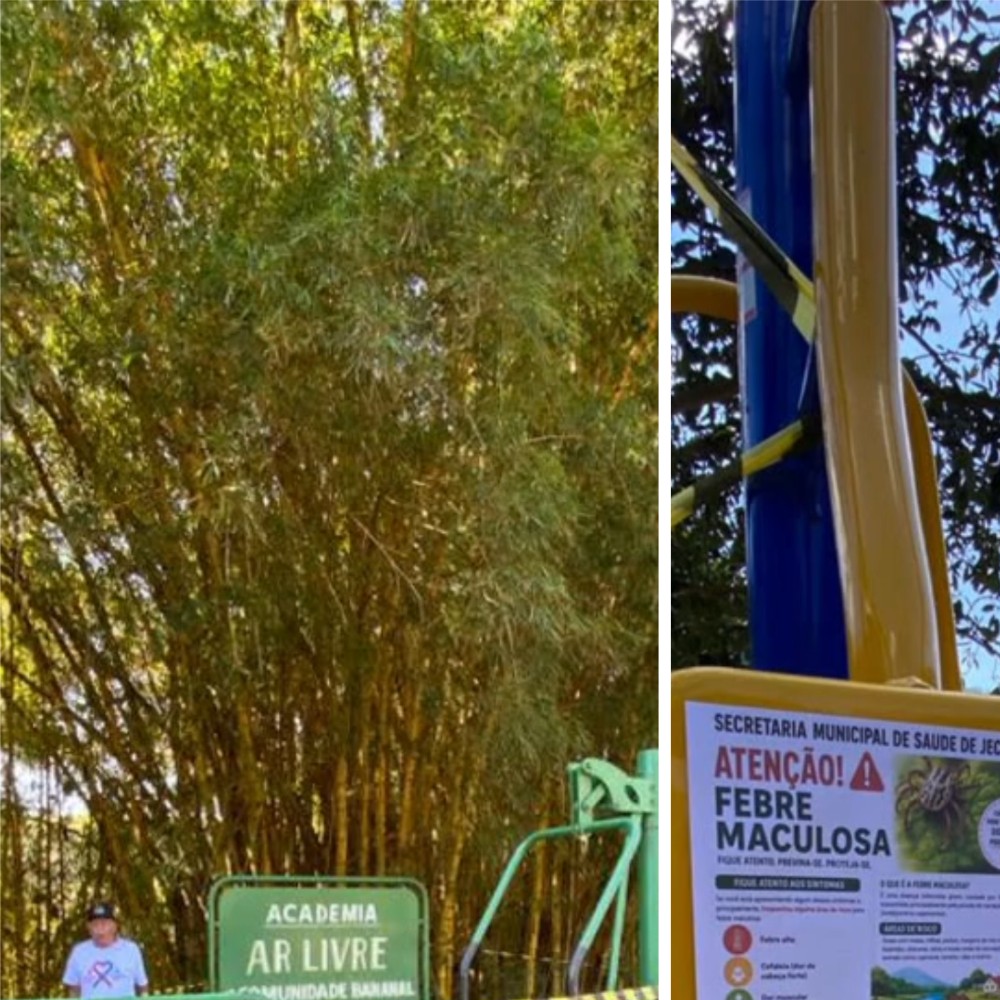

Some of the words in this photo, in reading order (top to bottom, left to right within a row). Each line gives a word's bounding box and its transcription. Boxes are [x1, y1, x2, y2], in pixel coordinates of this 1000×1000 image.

[714, 713, 807, 739] SECRETARIA
[813, 722, 888, 747] MUNICIPAL
[893, 731, 910, 748] DE
[961, 737, 976, 753] DE
[714, 745, 843, 789] ATENÇÃO!
[715, 786, 813, 821] FEBRE
[716, 820, 891, 856] MACULOSA
[266, 903, 377, 923] ACADEMIA
[246, 939, 291, 976] AR
[303, 936, 388, 972] LIVRE
